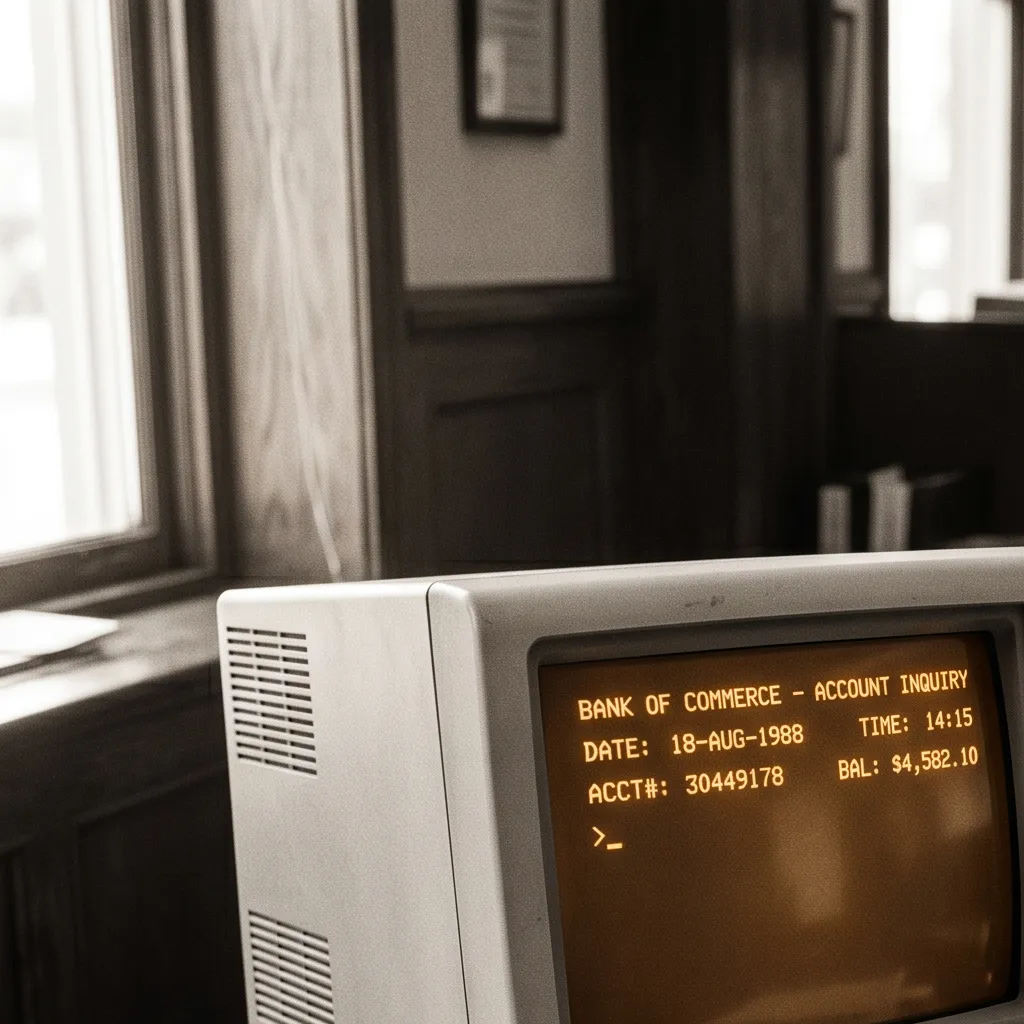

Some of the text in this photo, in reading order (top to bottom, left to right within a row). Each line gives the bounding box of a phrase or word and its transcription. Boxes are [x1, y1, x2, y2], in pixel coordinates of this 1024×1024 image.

[577, 696, 635, 721] BANK
[645, 693, 671, 716] OF
[683, 684, 782, 712] COMMERCE
[814, 675, 890, 702] ACCOUNT
[899, 669, 968, 695] INQUIRY
[582, 707, 973, 763] DATE: 18-AUG-1988 TIME: 14:15
[588, 745, 979, 805] ACCT#: 30449178 BAL: $4,582.10
